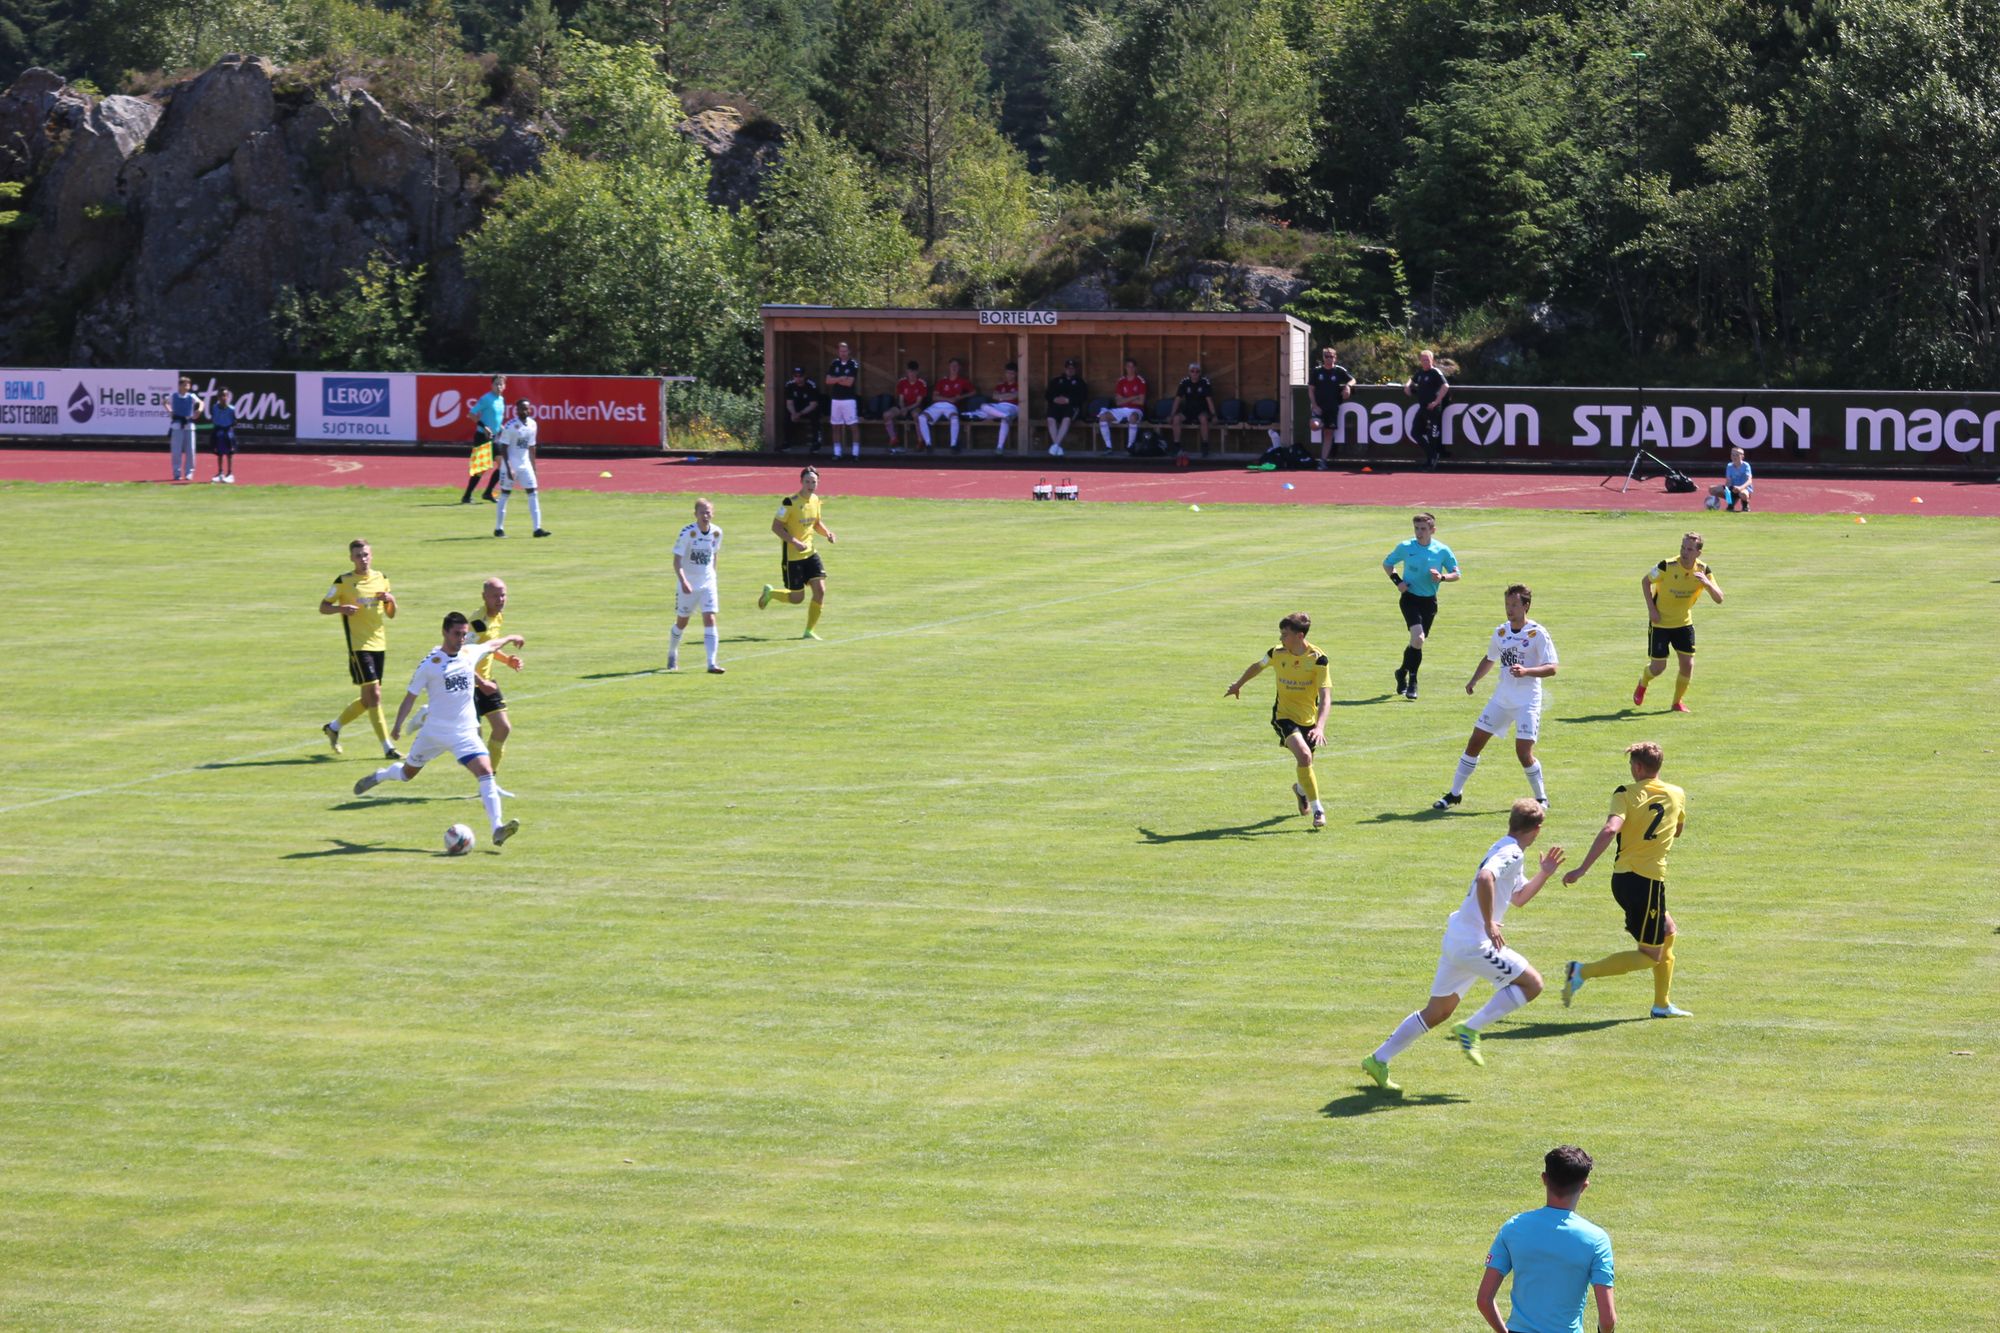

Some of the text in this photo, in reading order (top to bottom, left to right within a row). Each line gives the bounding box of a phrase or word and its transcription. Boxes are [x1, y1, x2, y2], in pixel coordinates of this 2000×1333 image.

[981, 311, 1056, 325] BORTELAG
[4, 380, 45, 400] BØMLO
[100, 387, 146, 406] Helle
[328, 387, 385, 405] LERØY
[100, 408, 126, 417] 5430
[323, 421, 390, 436] SJØTROLL
[1572, 405, 1810, 449] STADION
[1644, 803, 1664, 840] 2
